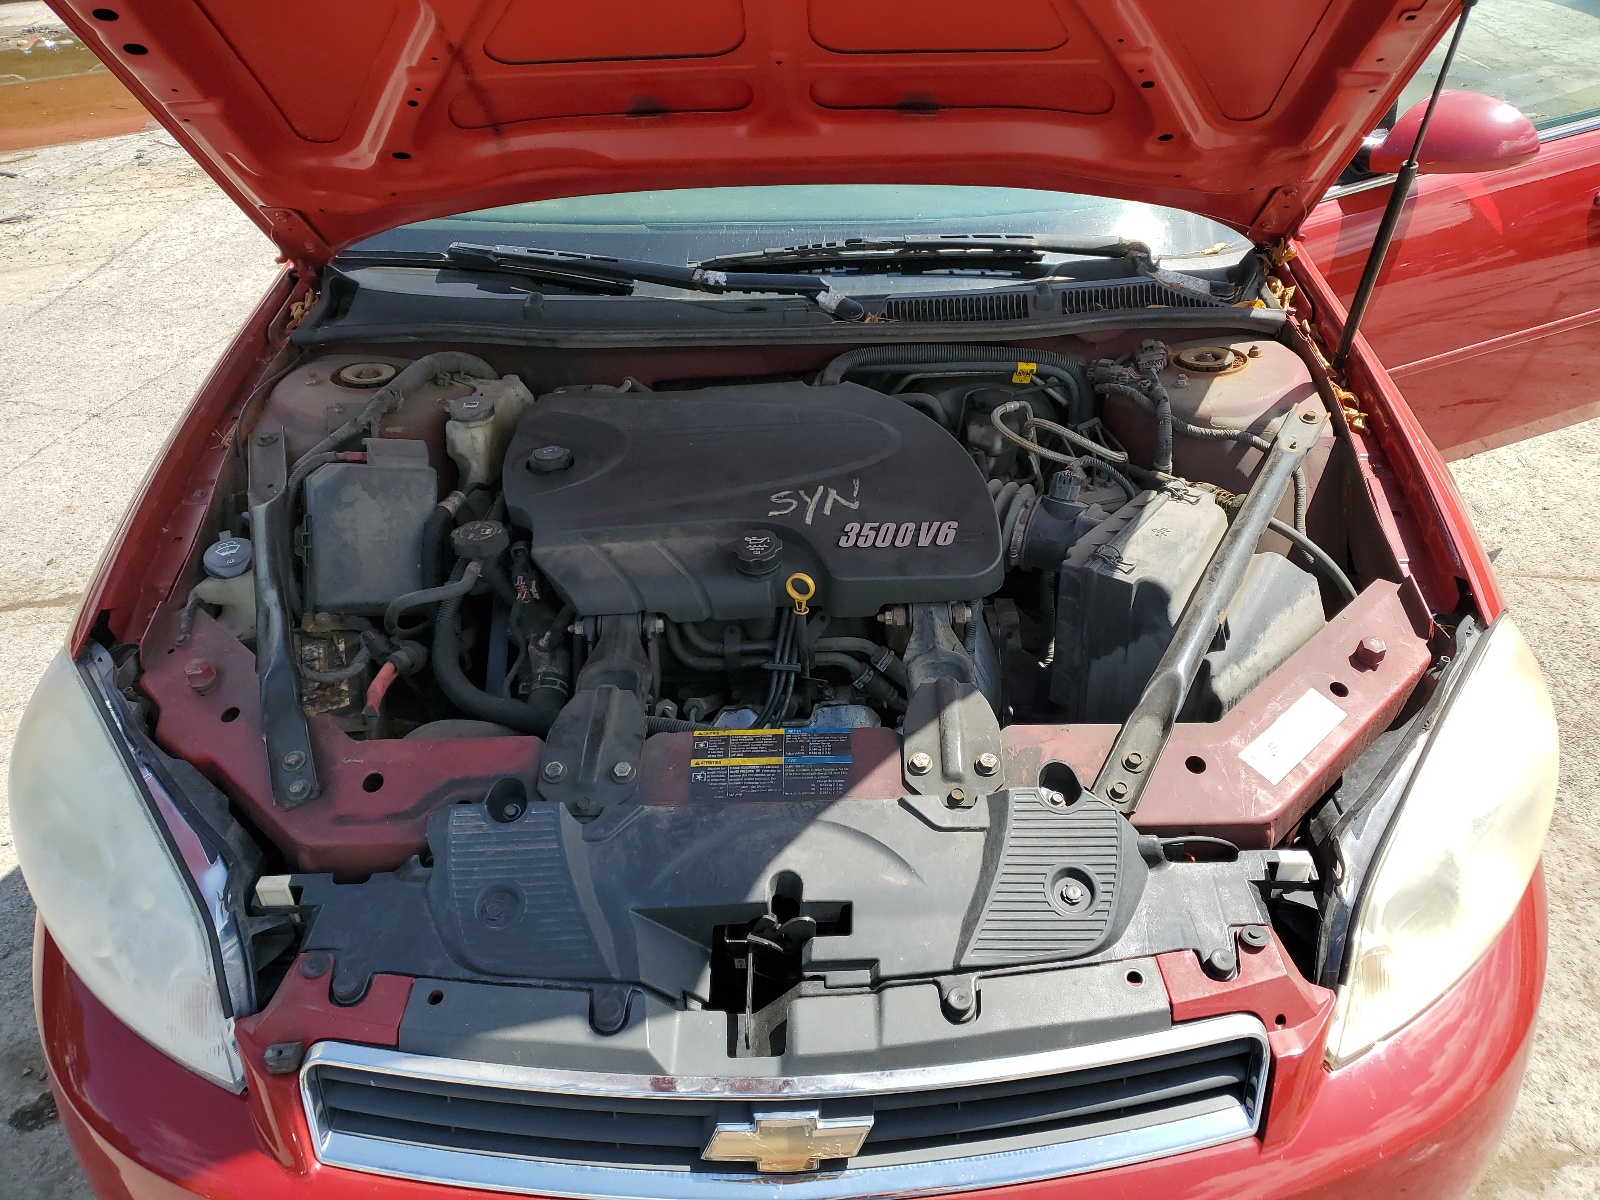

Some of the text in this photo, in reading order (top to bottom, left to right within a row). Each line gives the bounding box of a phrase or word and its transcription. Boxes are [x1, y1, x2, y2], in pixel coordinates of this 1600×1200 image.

[768, 478, 860, 526] SYN
[838, 520, 959, 548] 3500 V6
